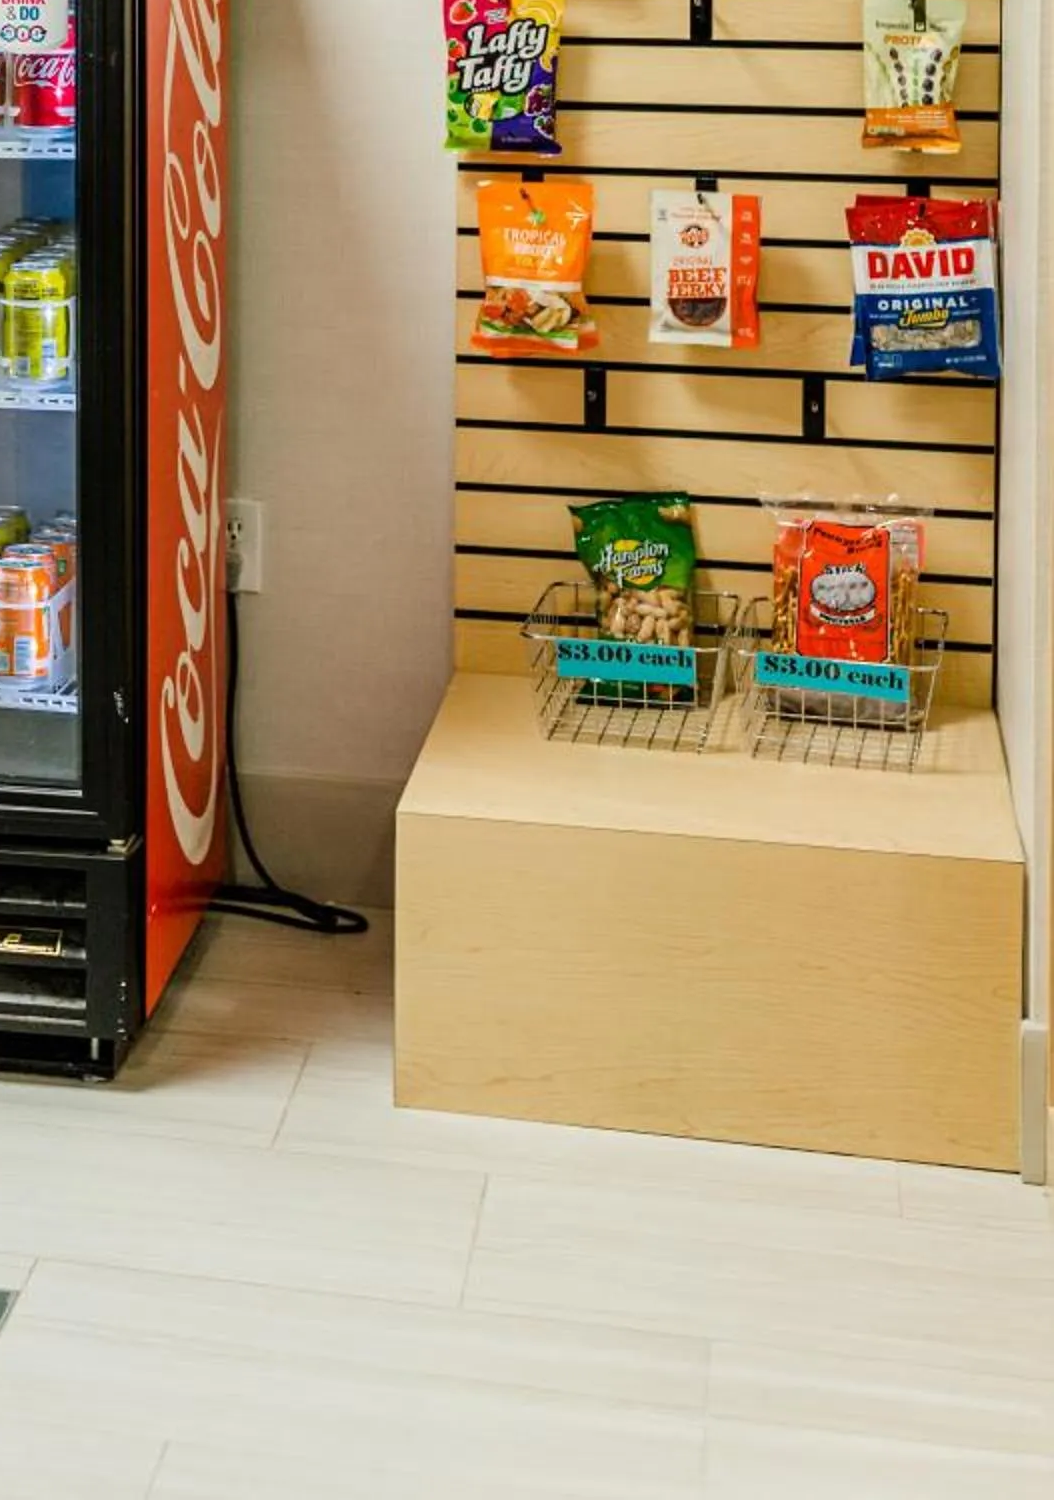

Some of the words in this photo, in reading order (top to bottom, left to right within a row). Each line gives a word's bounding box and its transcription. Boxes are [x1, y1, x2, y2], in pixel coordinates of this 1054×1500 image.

[20, 6, 40, 20] DO
[467, 19, 547, 60] Laffy
[457, 54, 534, 93] Taffy
[669, 268, 727, 282] BEEF
[867, 247, 976, 280] DAVID
[667, 283, 726, 297] JERKY
[877, 295, 969, 312] ORIGINAL
[594, 539, 668, 573] Hampton
[617, 558, 663, 587] Farms
[557, 643, 633, 664] $3.00
[637, 647, 694, 669] each
[763, 656, 841, 682] $3.00
[847, 668, 904, 691] each
